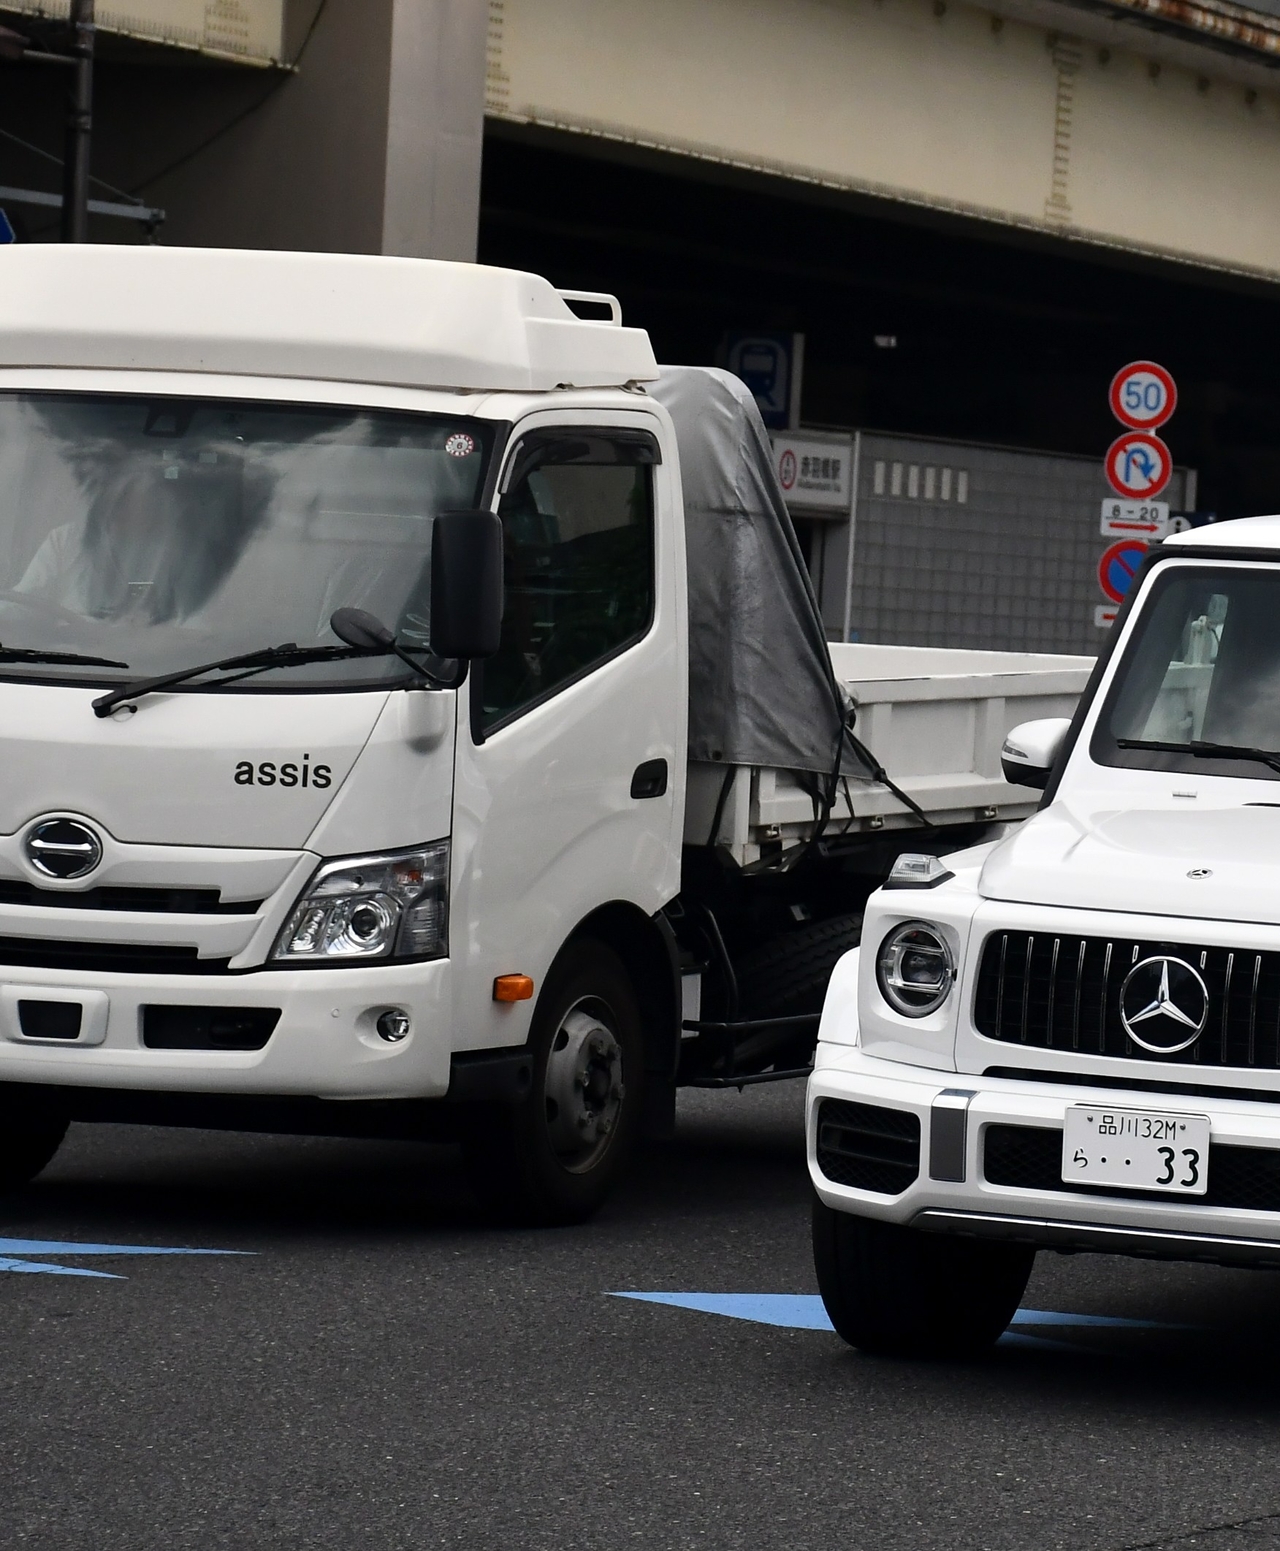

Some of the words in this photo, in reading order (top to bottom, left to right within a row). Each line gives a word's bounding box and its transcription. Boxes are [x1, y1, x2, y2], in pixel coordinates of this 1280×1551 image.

[1125, 380, 1162, 412] 50
[234, 753, 332, 789] assis
[1073, 1148, 1089, 1168] ら
